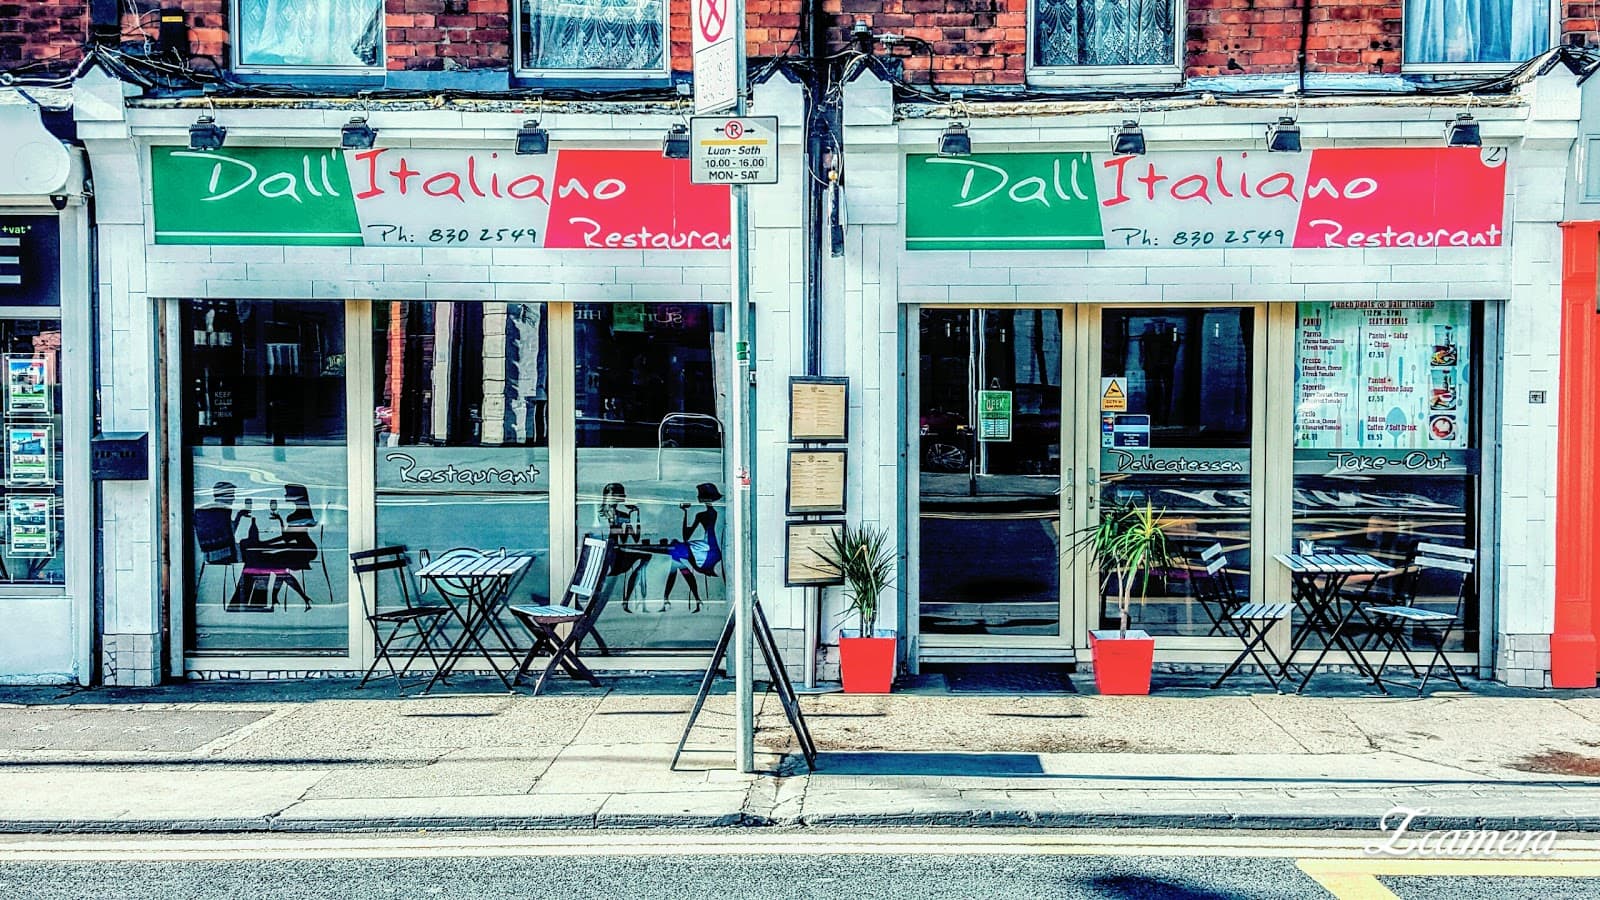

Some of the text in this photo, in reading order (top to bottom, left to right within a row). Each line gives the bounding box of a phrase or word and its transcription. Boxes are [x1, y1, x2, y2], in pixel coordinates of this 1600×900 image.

[708, 146, 731, 155] Luan
[738, 146, 761, 155] Sath
[706, 159, 730, 168] 10.00
[740, 159, 765, 167] 16.00
[355, 148, 626, 205] Italiano
[1102, 151, 1378, 206] Italiano
[367, 225, 537, 243] Ph: 830 2549
[568, 217, 732, 248] Restauran
[1112, 227, 1284, 246] Ph: 830 2549
[1309, 219, 1502, 248] Restaurant
[386, 452, 541, 485] Restaurant
[1107, 449, 1243, 473] Delicatessen
[1327, 451, 1451, 472] Take-Out
